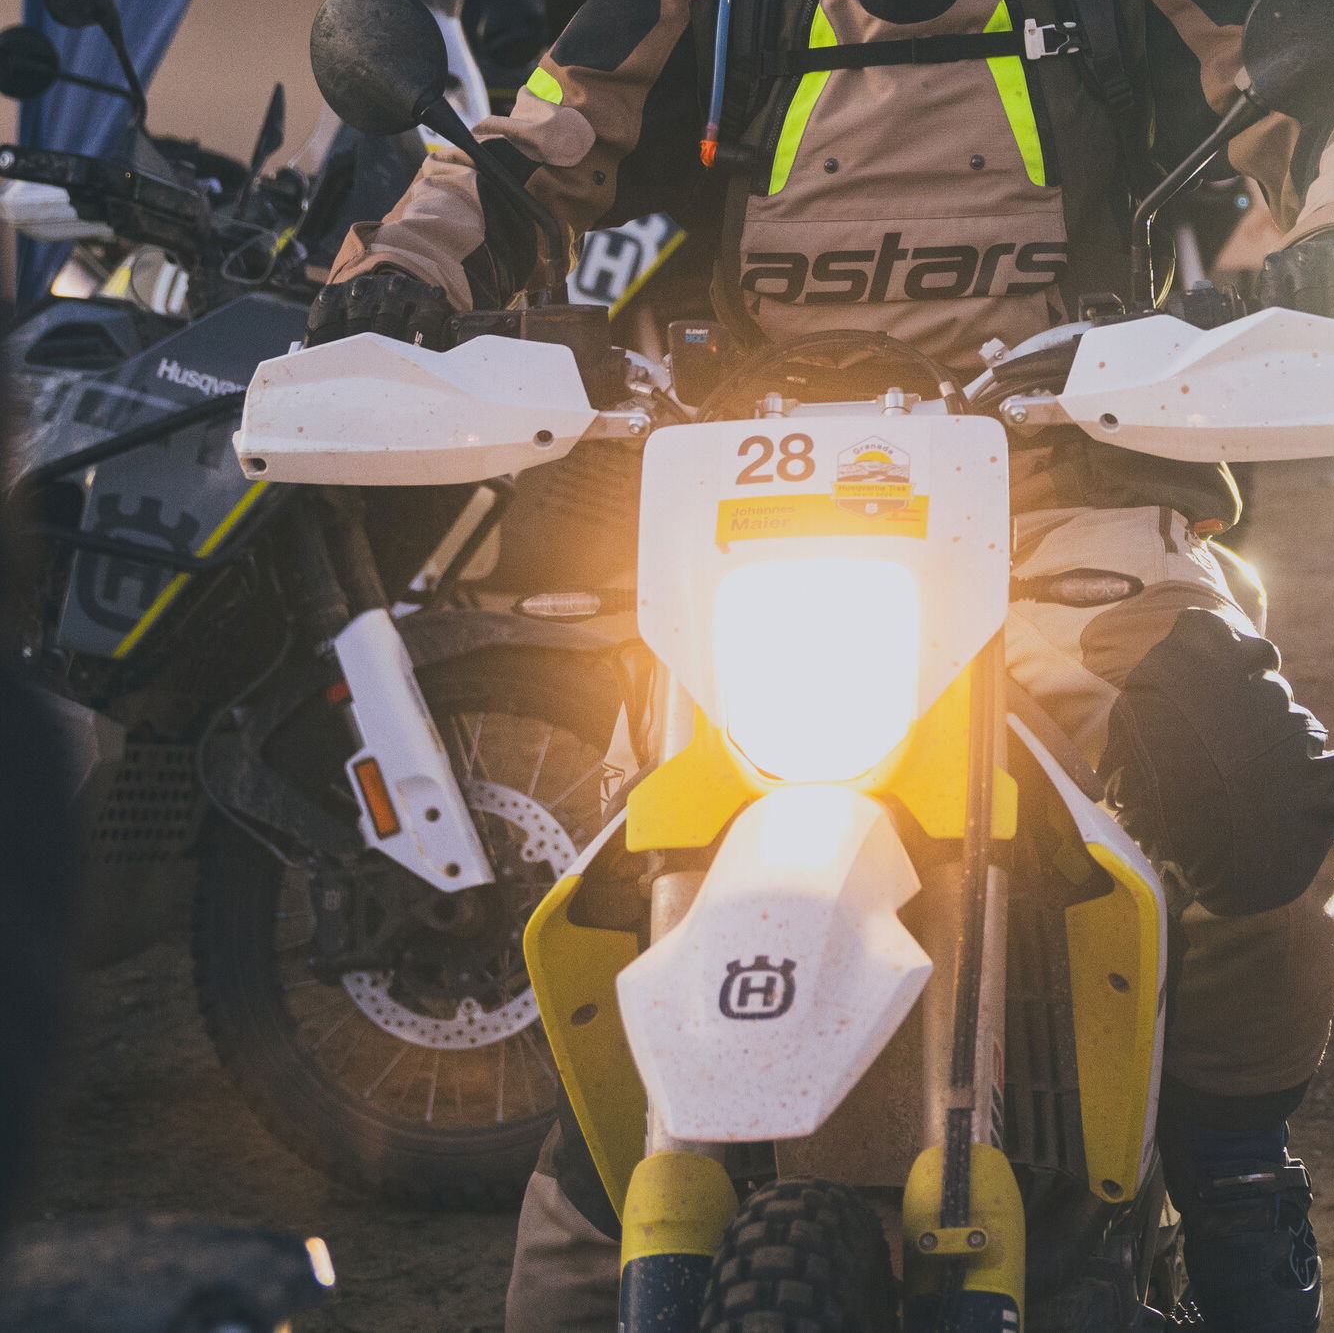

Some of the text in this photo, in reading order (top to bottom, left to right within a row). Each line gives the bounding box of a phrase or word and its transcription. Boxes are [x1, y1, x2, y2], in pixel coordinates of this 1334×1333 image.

[741, 231, 1069, 304] astars
[736, 433, 816, 485] 28
[731, 517, 792, 531] Maier
